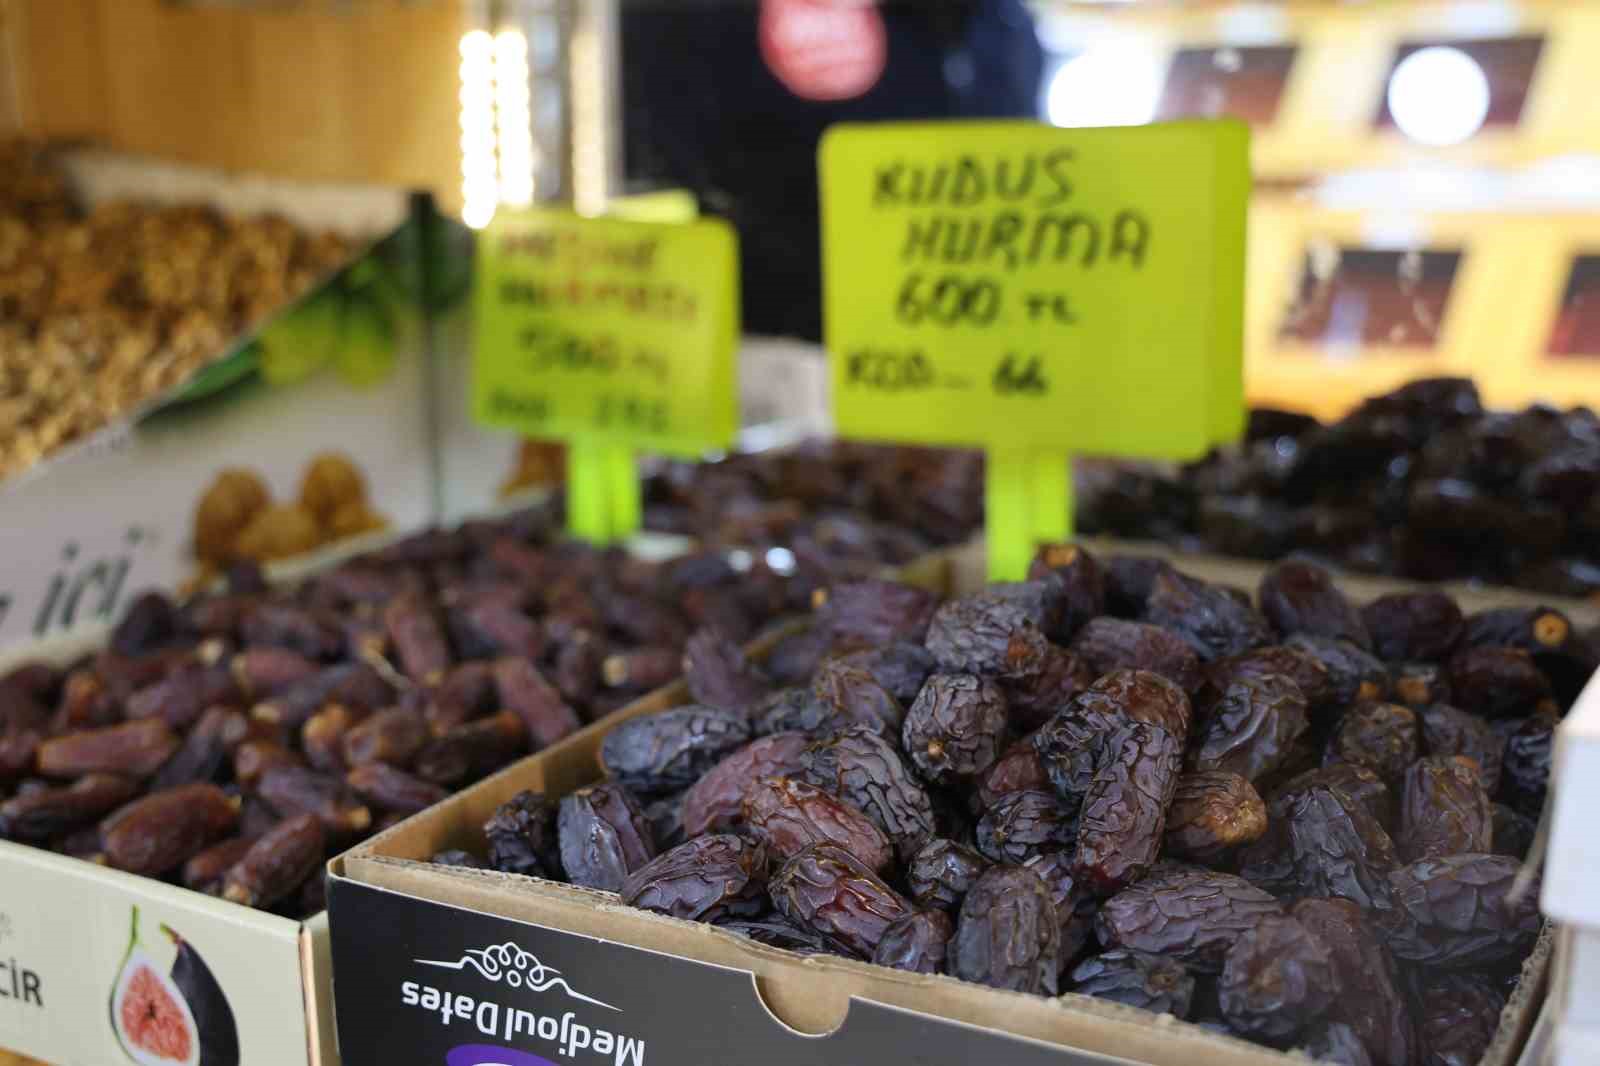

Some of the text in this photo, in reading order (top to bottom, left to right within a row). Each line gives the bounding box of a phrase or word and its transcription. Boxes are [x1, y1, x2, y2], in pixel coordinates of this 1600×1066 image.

[874, 150, 1076, 209] KUDUS
[904, 208, 1150, 270] HURMA
[897, 273, 1000, 327] 600
[992, 352, 1048, 395] 66
[402, 980, 645, 1066] Medjoul Dates
